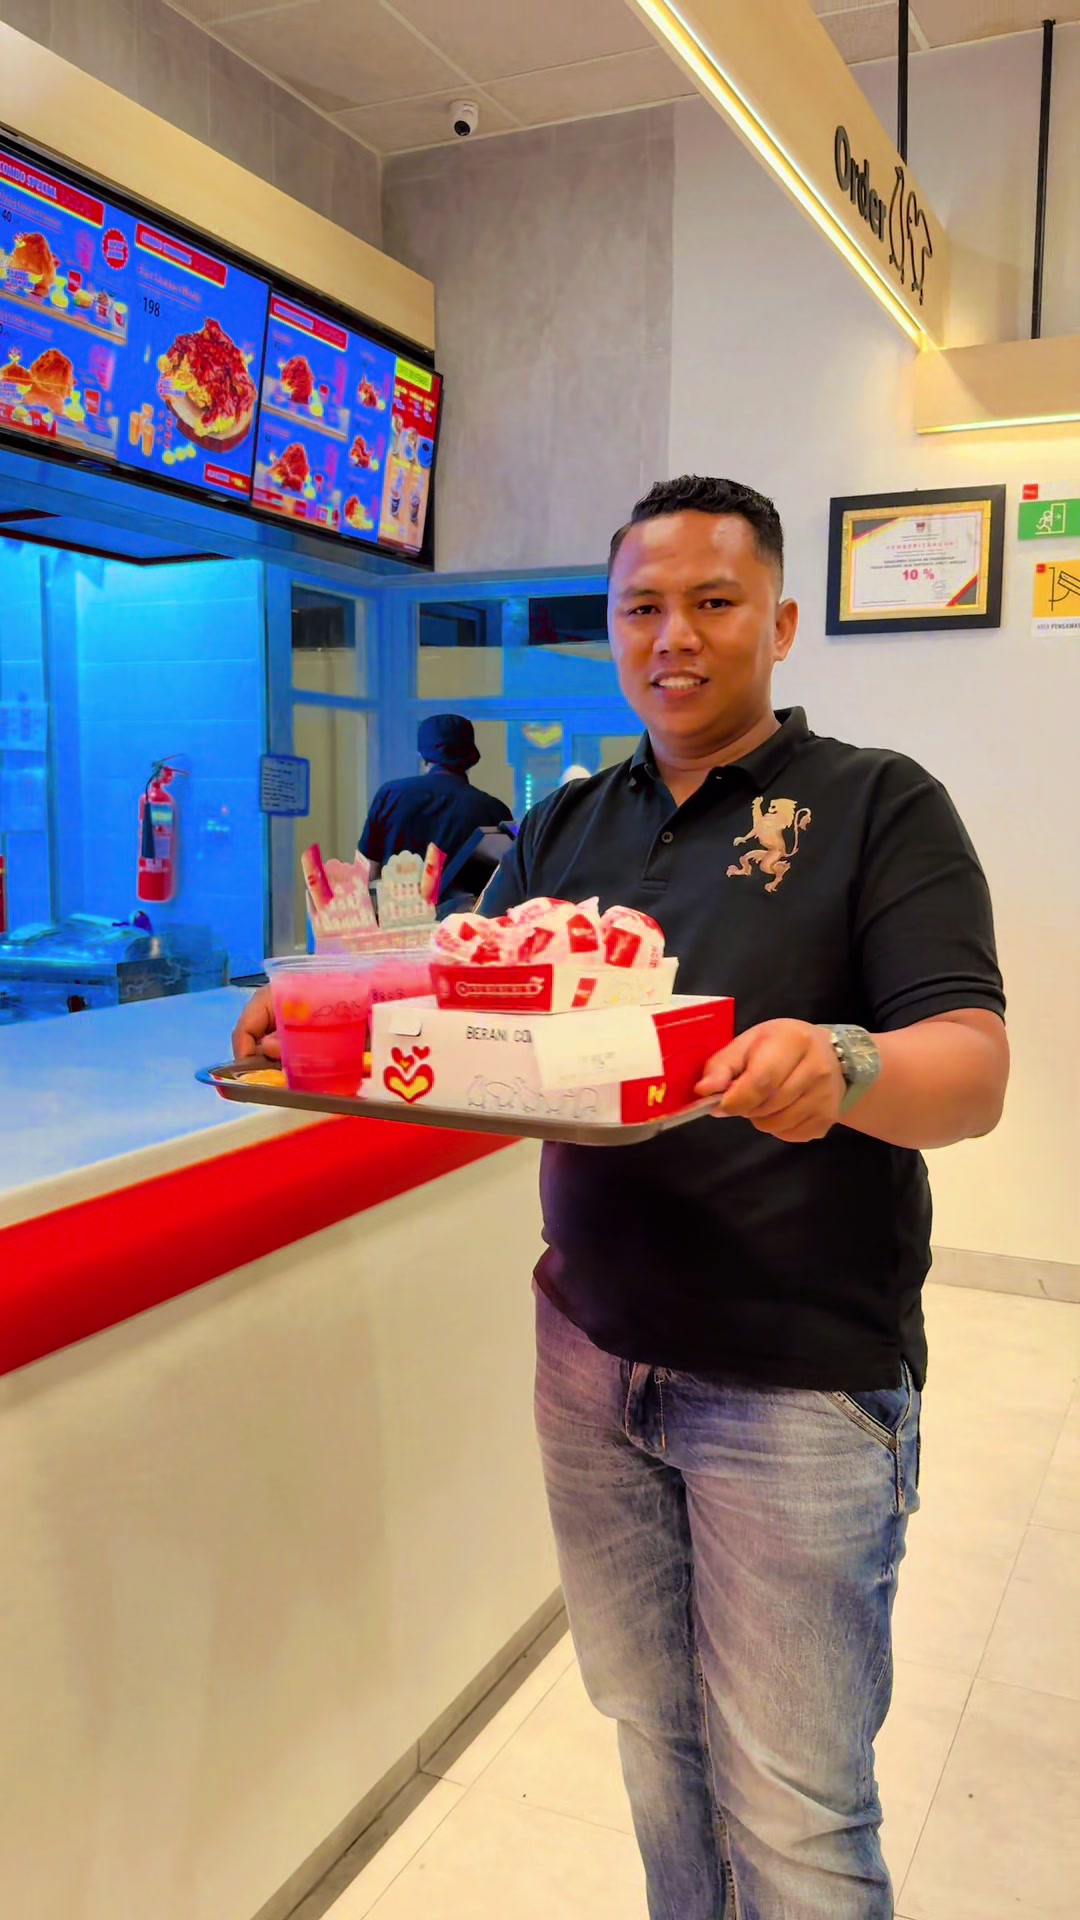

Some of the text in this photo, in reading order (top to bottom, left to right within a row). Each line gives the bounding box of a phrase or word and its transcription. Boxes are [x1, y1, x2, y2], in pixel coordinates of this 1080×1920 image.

[0, 161, 26, 183] COMBO
[835, 125, 886, 242] Order
[143, 297, 160, 317] 198
[903, 568, 935, 581] 10 %
[466, 1025, 508, 1041] BERANI
